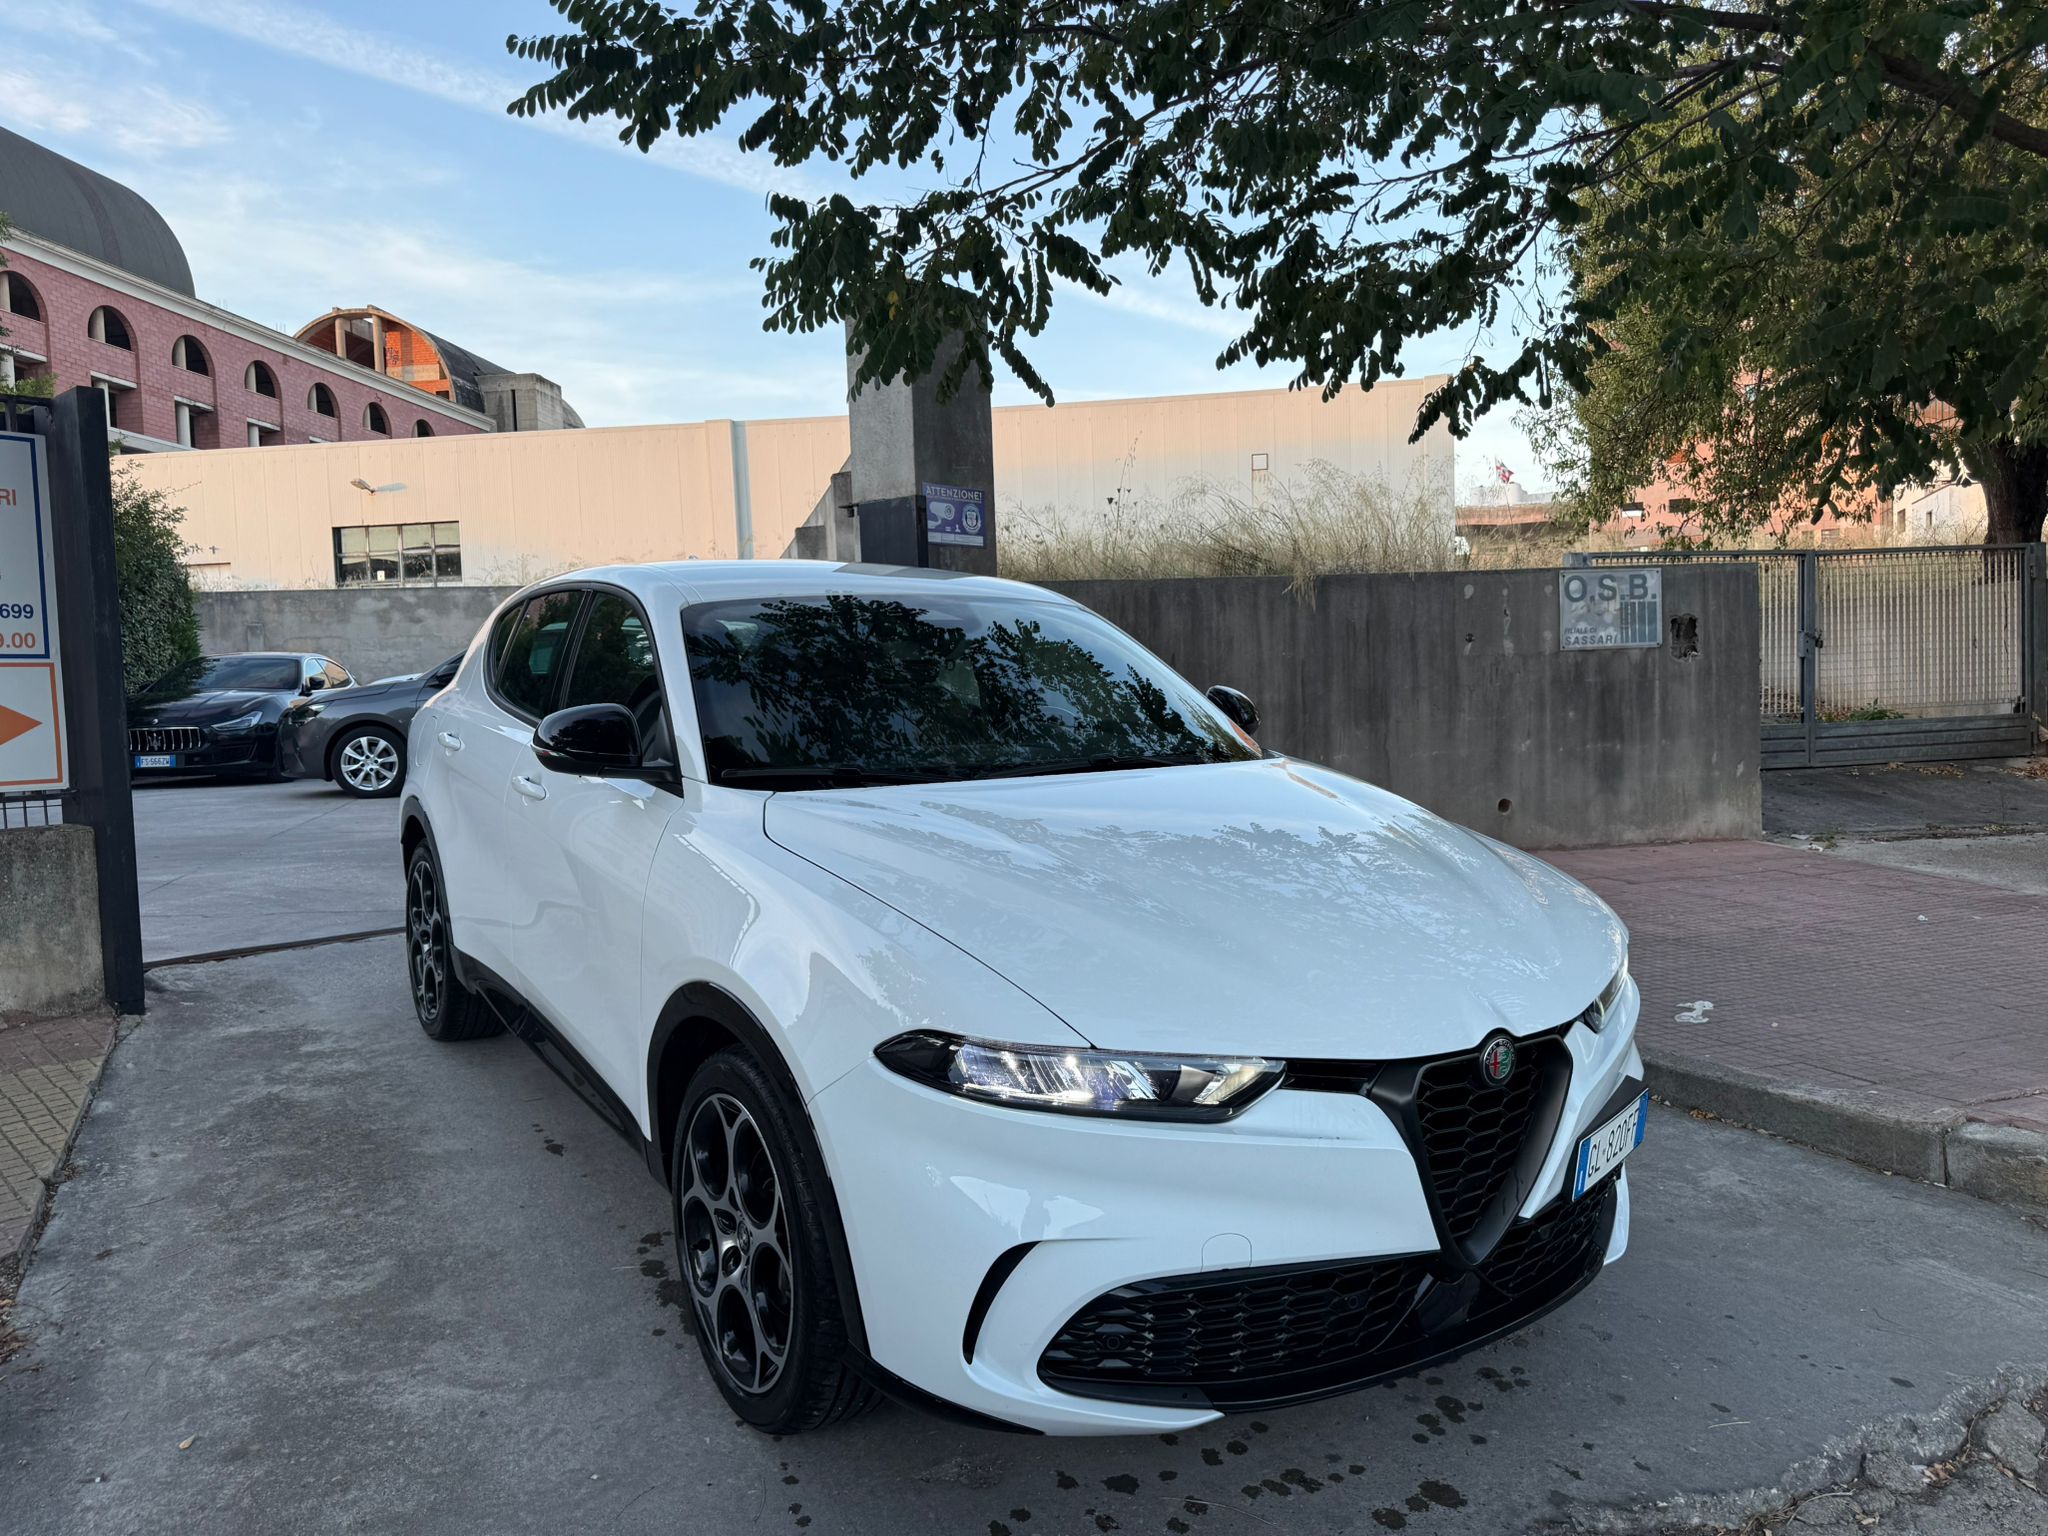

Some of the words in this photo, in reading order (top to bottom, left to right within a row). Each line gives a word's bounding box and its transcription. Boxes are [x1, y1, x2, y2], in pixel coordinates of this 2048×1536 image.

[926, 485, 982, 501] ATTENZIONE!
[1564, 574, 1657, 603] O.S.B.
[0, 603, 34, 619] 699
[1564, 634, 1618, 646] SASSARI
